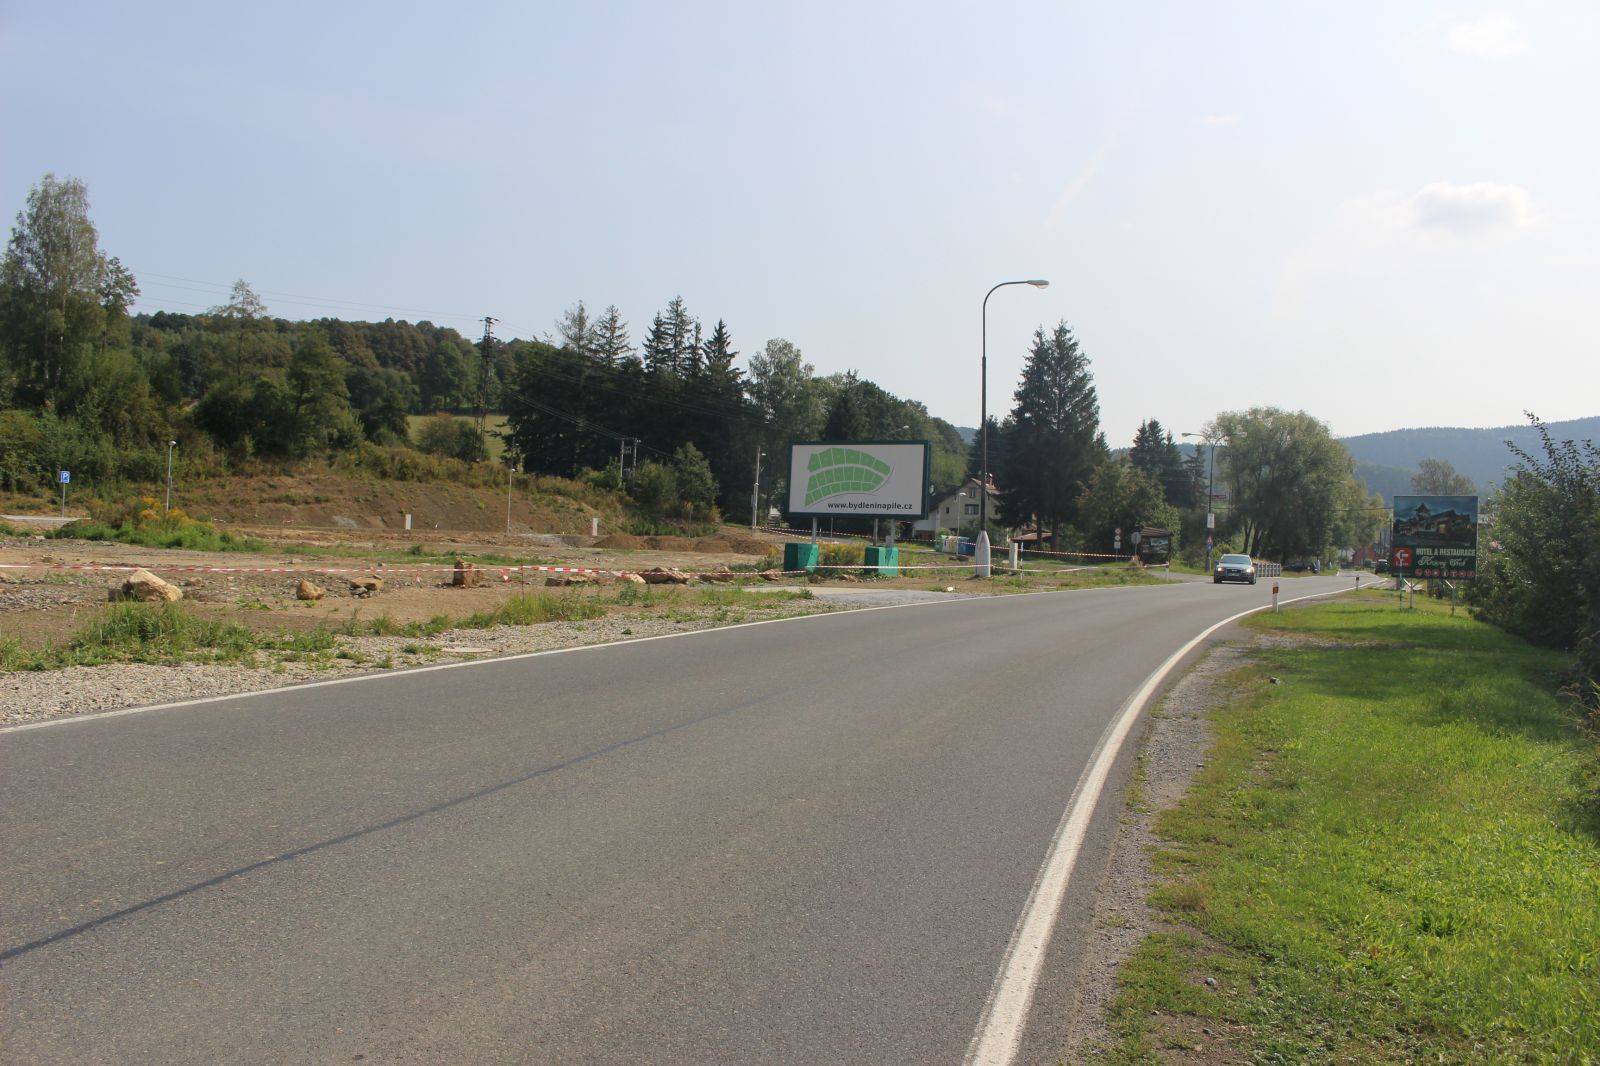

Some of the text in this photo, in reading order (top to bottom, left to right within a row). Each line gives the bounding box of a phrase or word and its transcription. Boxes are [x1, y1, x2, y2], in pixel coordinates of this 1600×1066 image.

[827, 501, 913, 511] www.bydleninapile.cz
[1416, 548, 1433, 556] HOTEL
[1440, 548, 1476, 556] RESTAURACE
